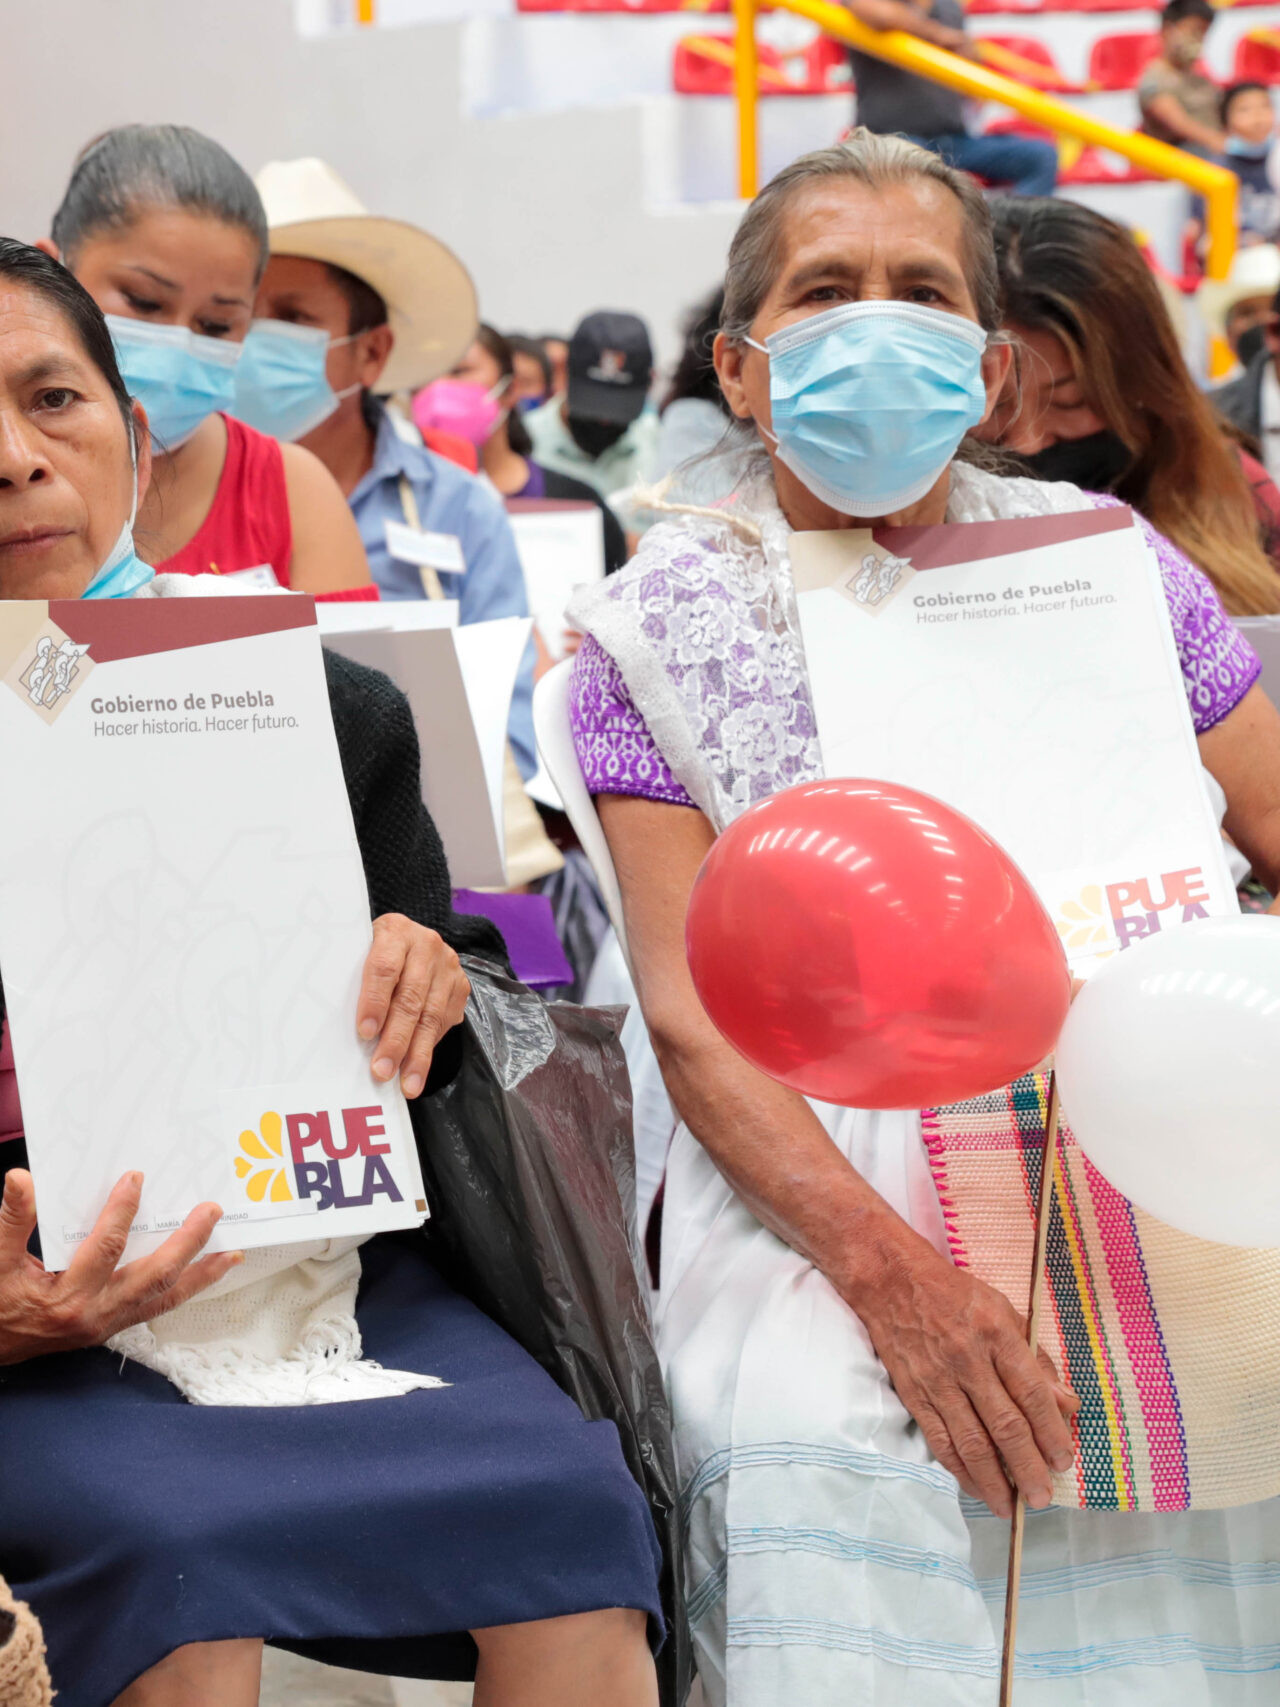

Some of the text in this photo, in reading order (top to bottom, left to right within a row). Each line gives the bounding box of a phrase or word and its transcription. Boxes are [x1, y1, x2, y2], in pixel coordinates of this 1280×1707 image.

[912, 578, 1093, 609] Gobierno de Puebla
[916, 592, 1118, 625] Hacer historia. Hacer futuro.
[90, 689, 275, 715] Gobierno de Puebla
[94, 712, 300, 737] Hacer historia. Hacer futuro.
[1105, 866, 1210, 921] PUE
[285, 1105, 392, 1164] PUE
[294, 1154, 404, 1211] BLA
